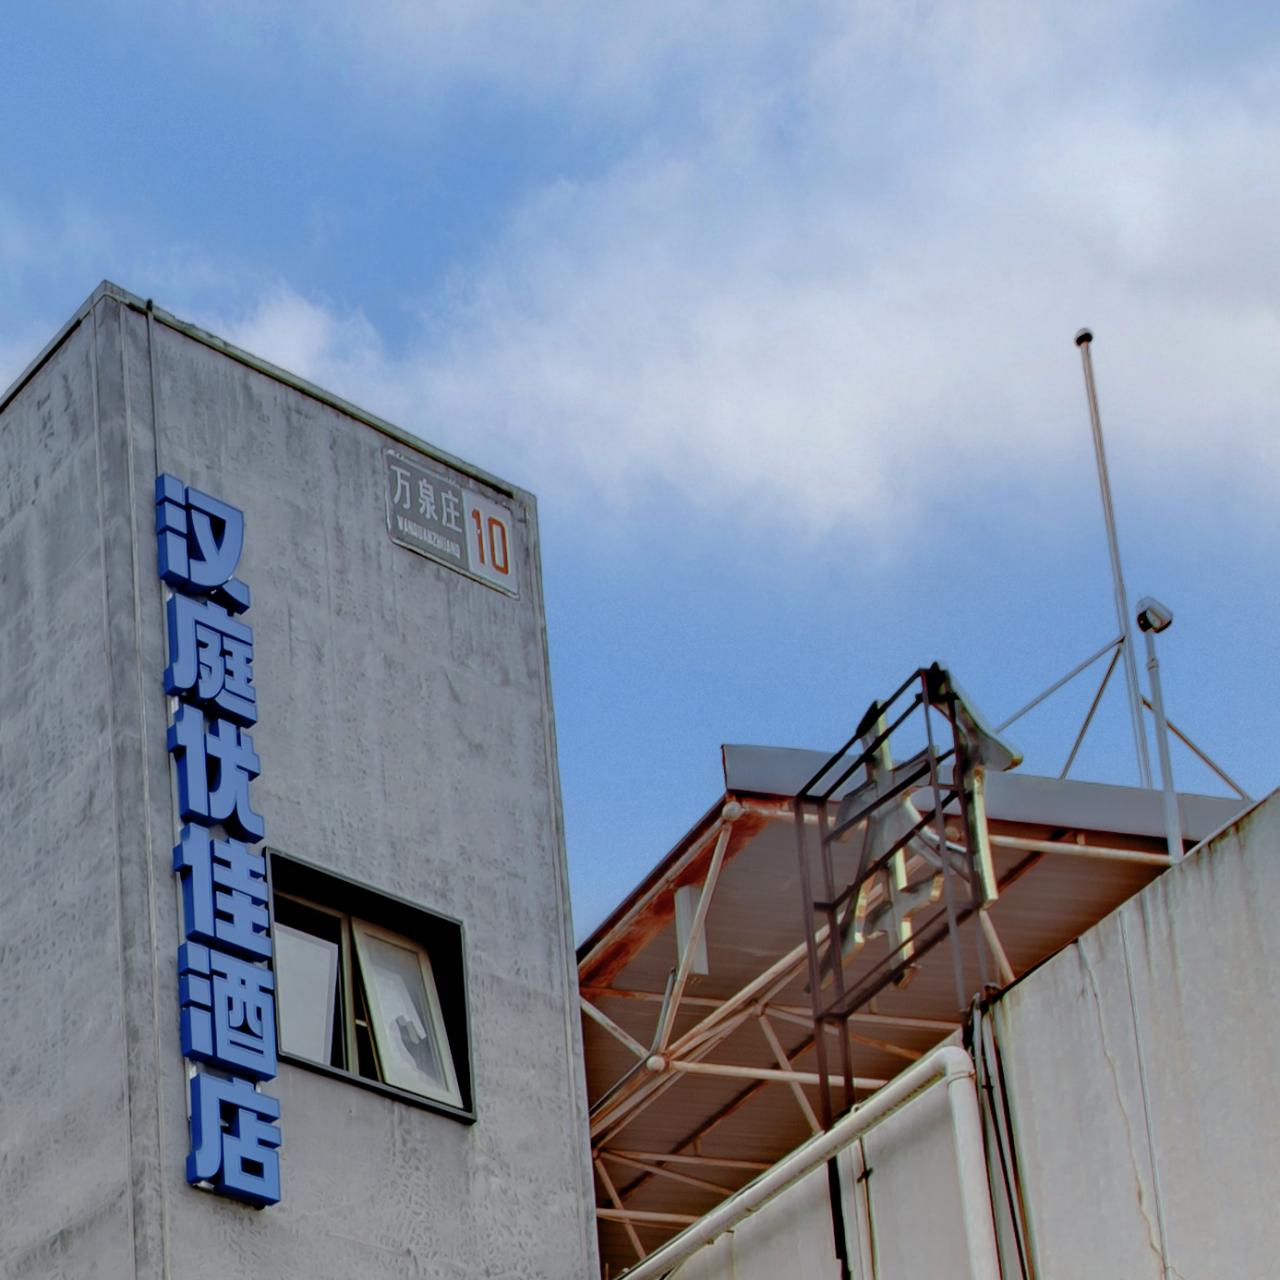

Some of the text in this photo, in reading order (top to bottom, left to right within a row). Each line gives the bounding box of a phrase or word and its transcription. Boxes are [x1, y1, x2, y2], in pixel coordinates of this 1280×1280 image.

[390, 465, 463, 533] 万泉庄
[472, 507, 509, 575] 10
[156, 472, 281, 1207] 汉庭优佳酒店
